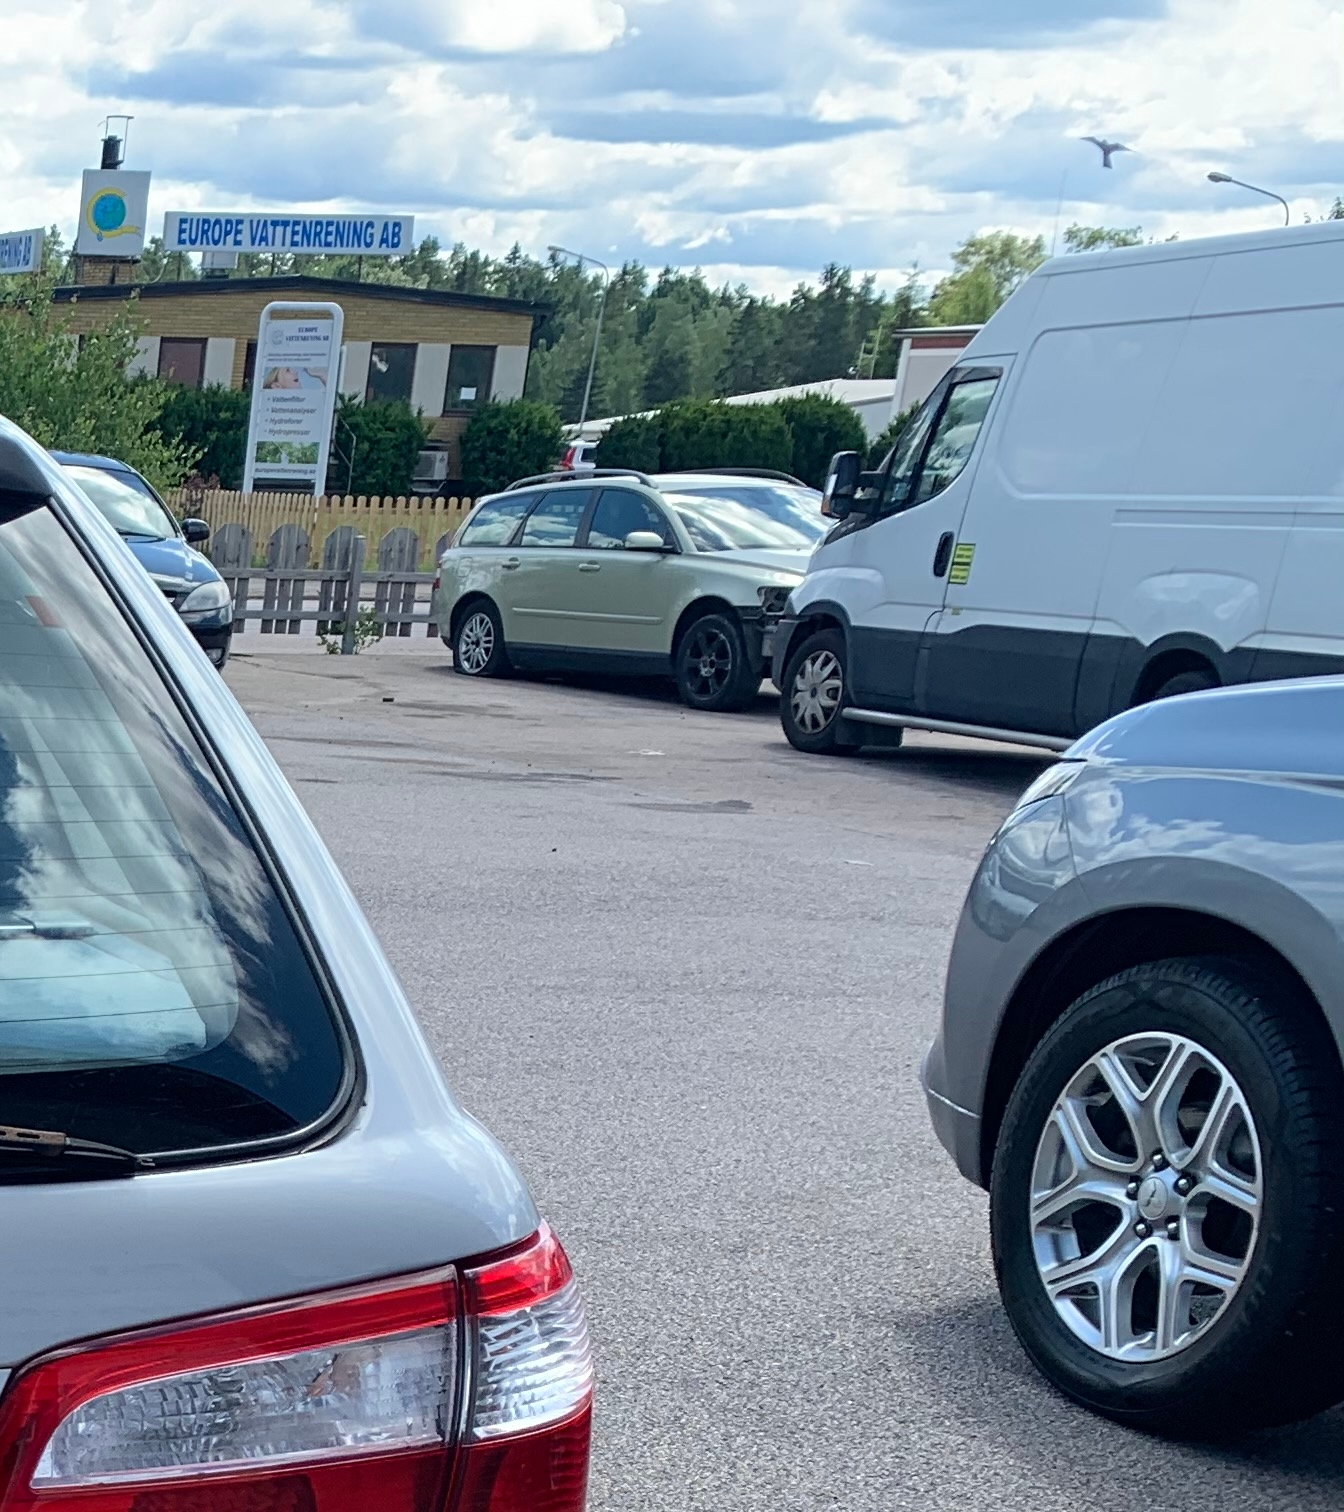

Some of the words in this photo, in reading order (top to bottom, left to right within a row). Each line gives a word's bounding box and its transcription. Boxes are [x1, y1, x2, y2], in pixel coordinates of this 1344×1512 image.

[177, 217, 244, 246] EUROPE
[249, 218, 375, 248] VATTENRENING
[379, 220, 403, 249] AB
